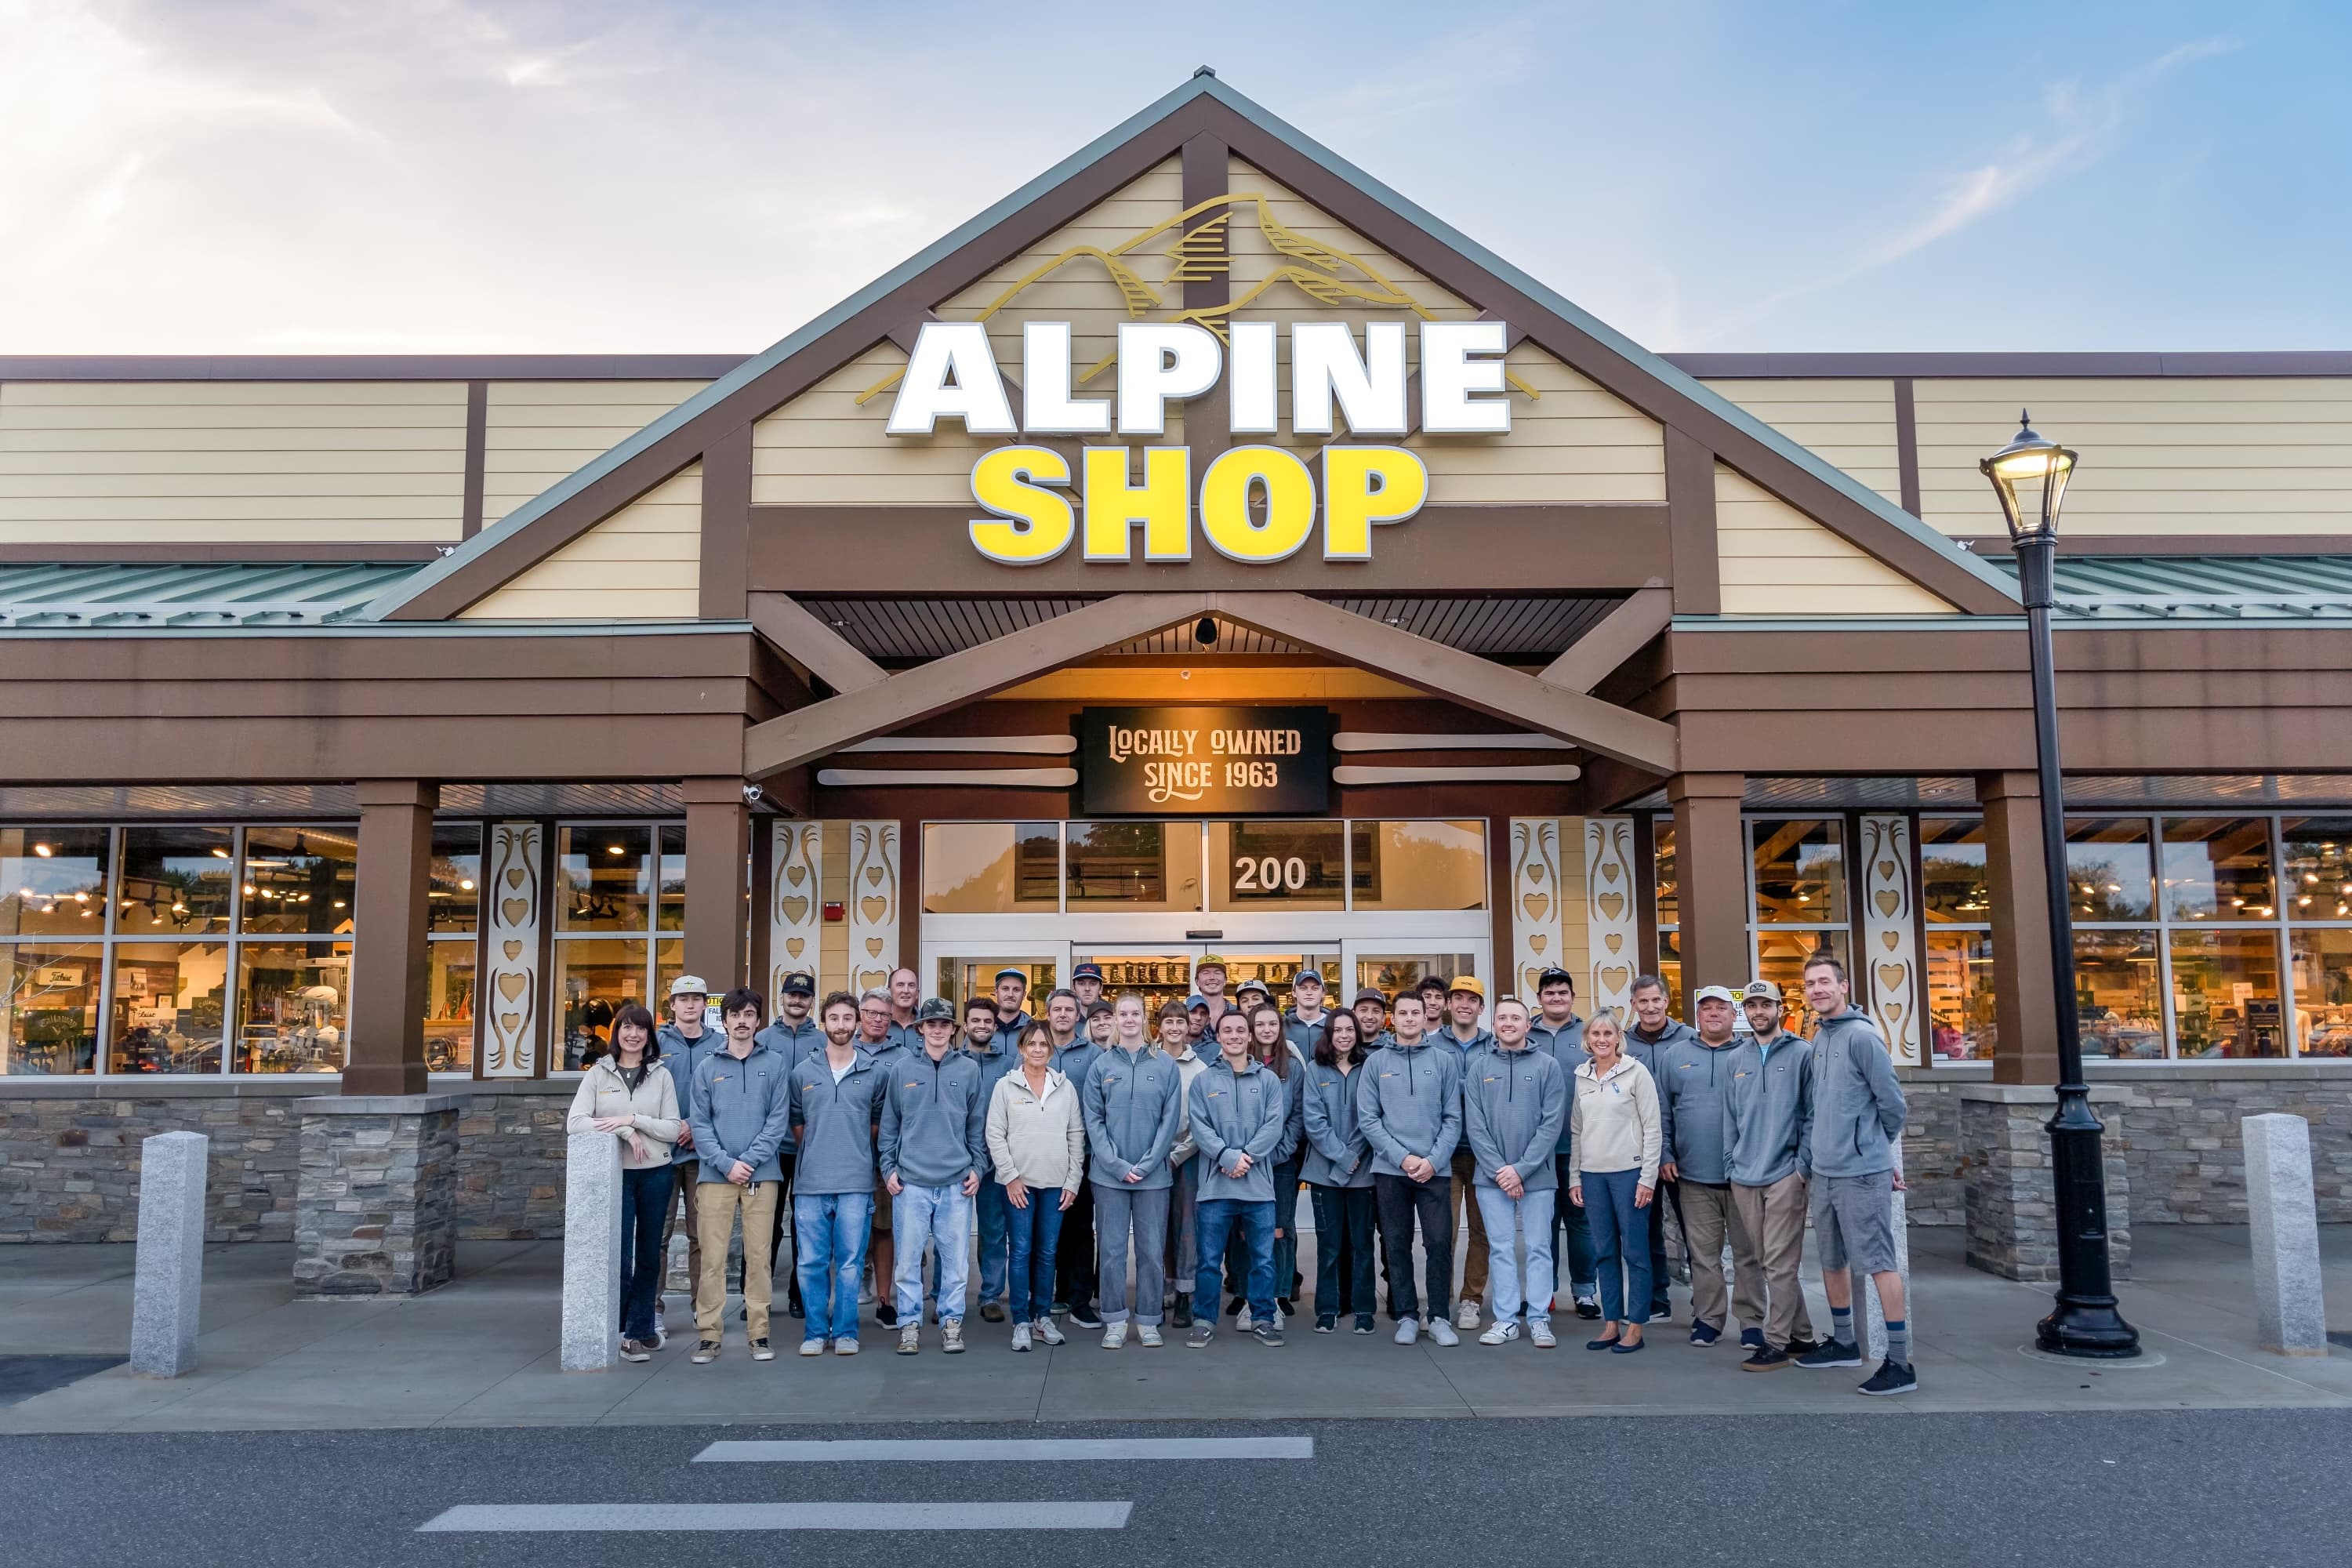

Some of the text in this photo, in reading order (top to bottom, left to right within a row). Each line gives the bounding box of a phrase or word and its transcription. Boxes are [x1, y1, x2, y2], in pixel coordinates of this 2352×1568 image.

[885, 321, 1512, 437] ALPINE
[968, 445, 1430, 566] SHOP
[1210, 729, 1301, 755] OWNED
[1144, 761, 1279, 803] SINCE 1963
[1235, 857, 1306, 890] 200
